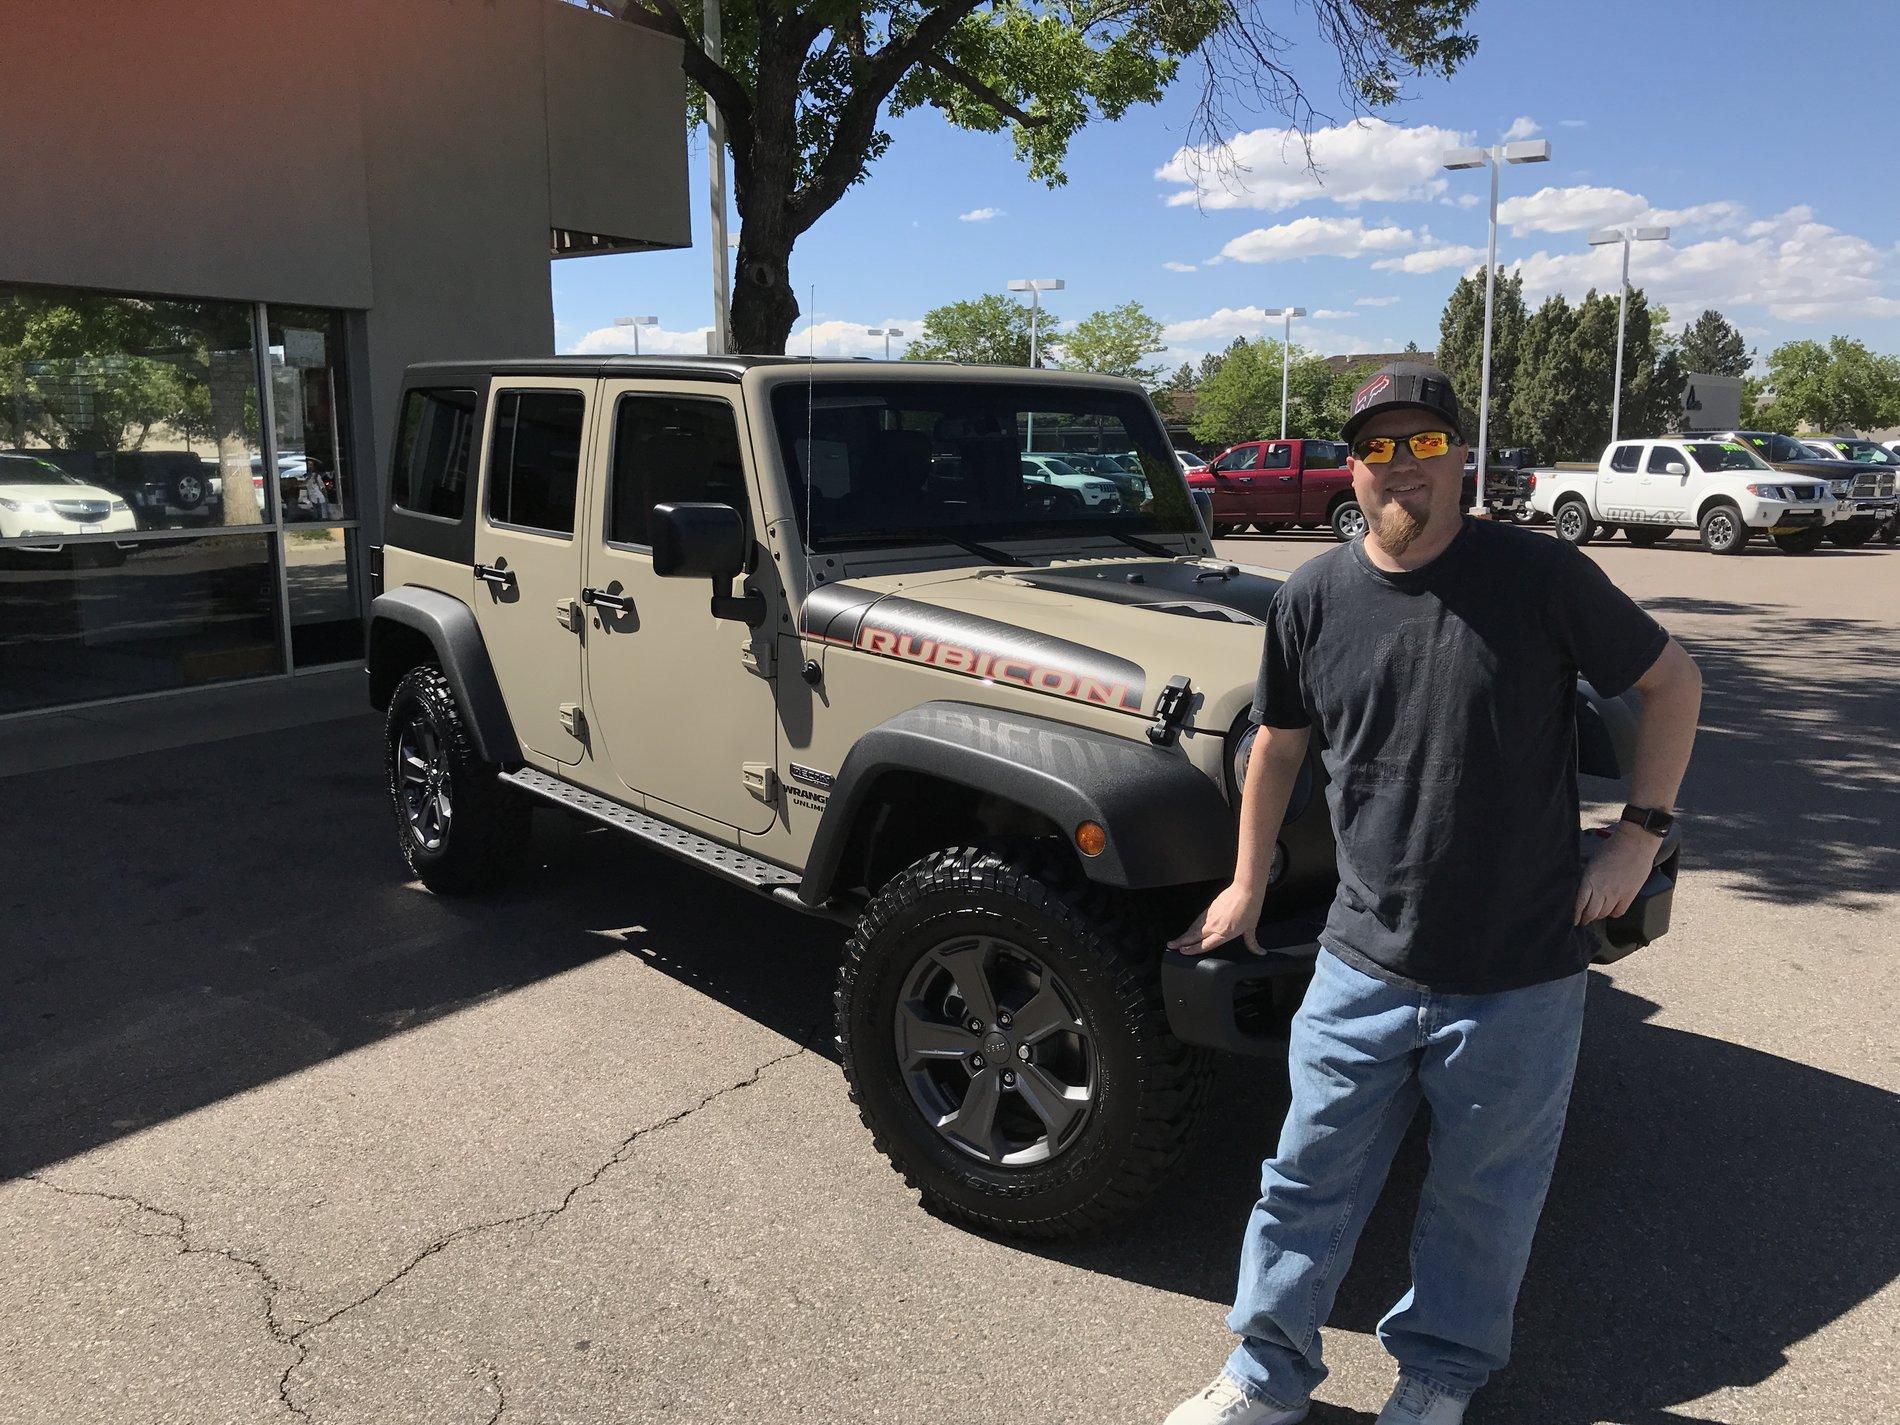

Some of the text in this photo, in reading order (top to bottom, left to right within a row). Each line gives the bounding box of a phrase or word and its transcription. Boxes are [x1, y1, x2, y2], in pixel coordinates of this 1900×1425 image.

[1607, 508, 1685, 524] PRO-4X
[857, 627, 1140, 711] RUBICON
[794, 799, 825, 812] UNLIMI
